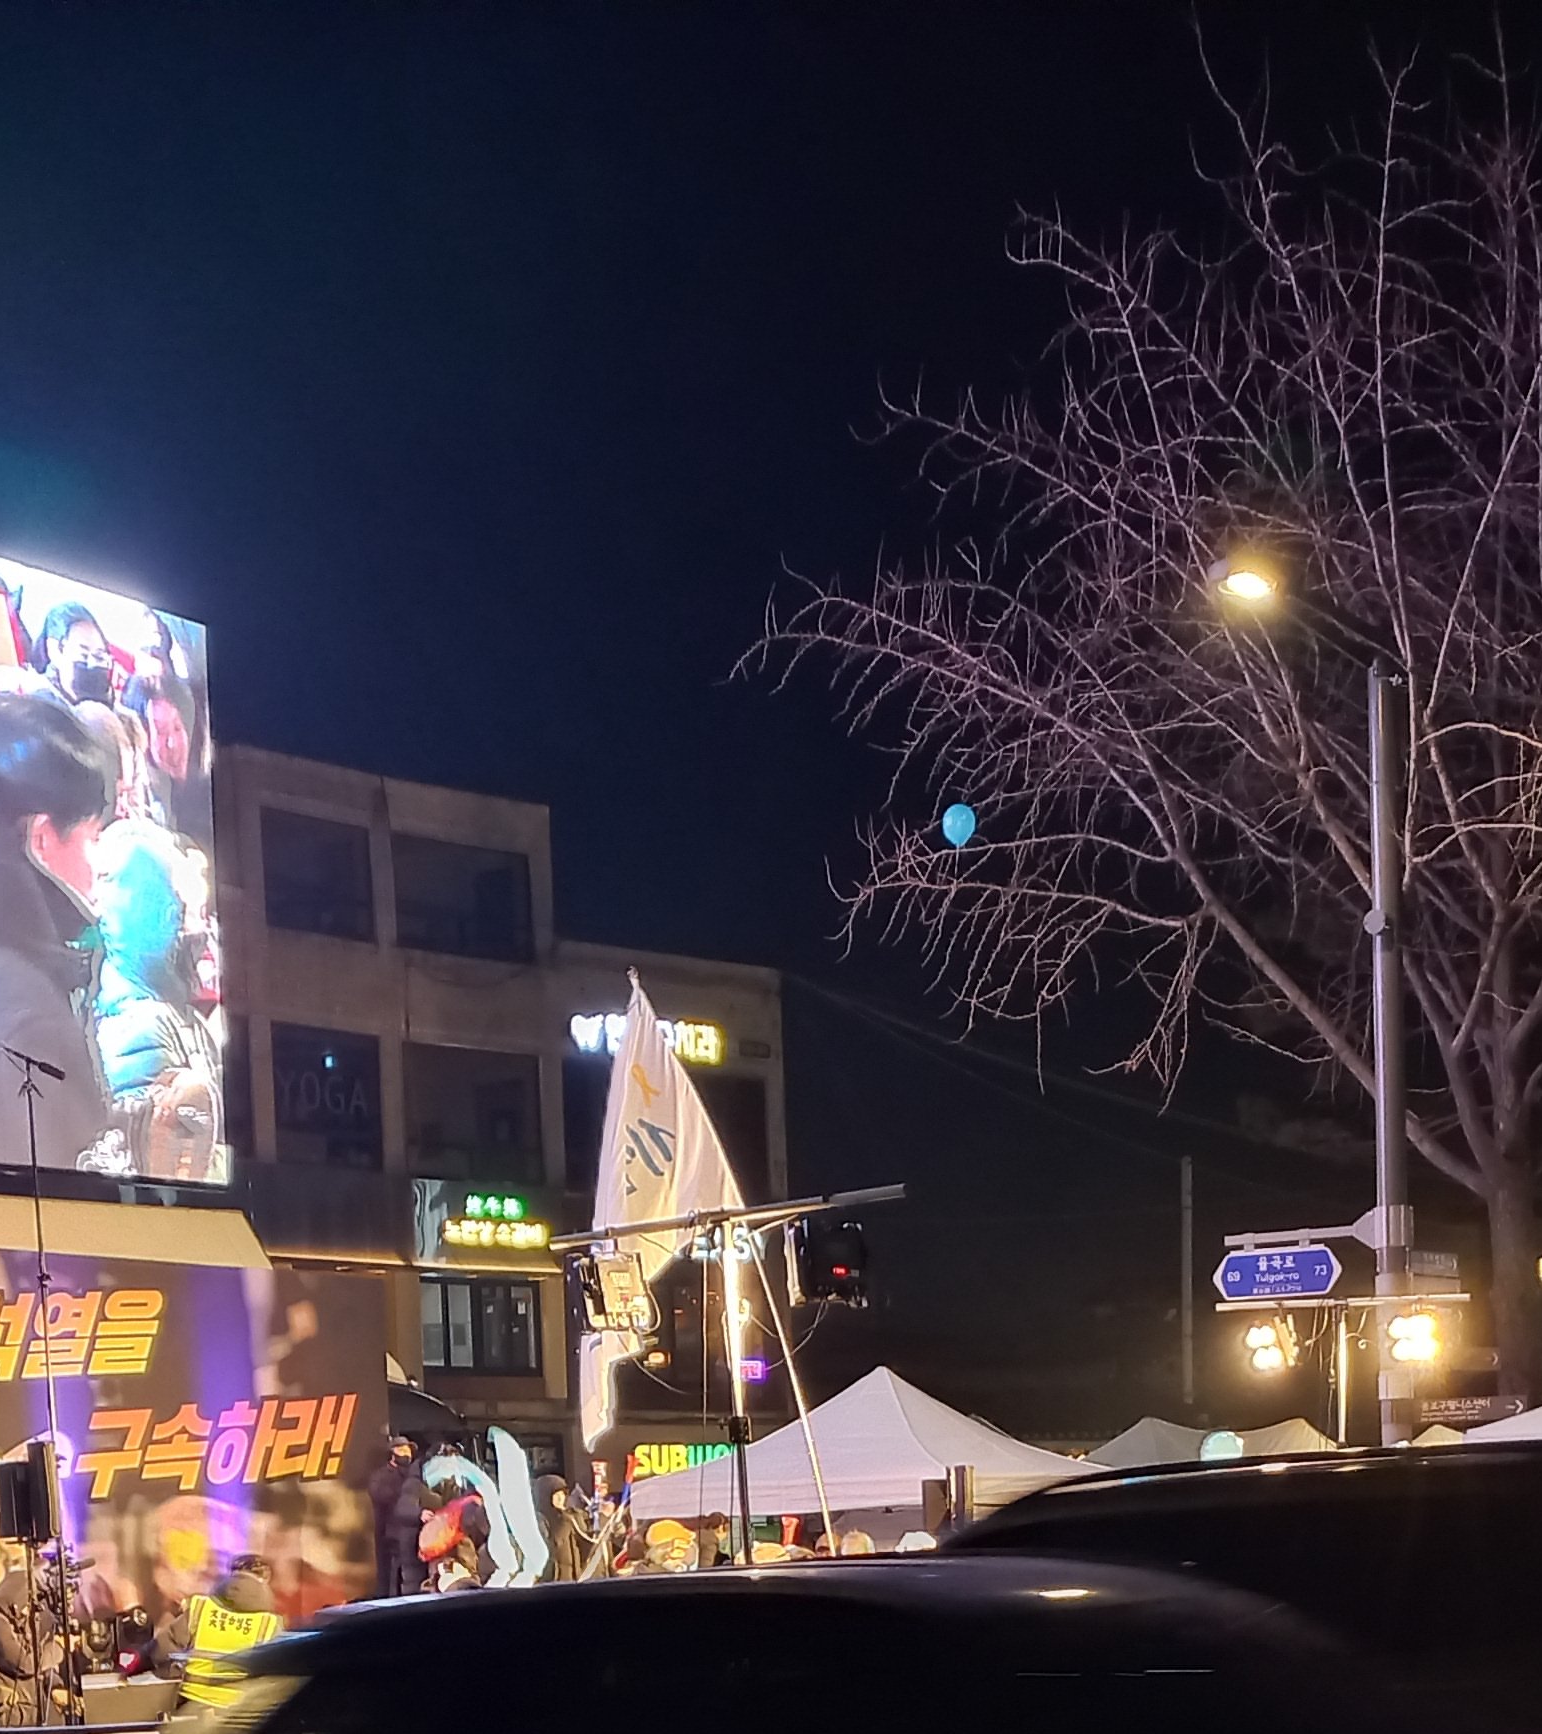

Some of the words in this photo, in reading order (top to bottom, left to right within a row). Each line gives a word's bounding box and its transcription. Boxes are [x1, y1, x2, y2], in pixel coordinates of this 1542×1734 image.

[276, 1070, 369, 1115] YOGA
[1257, 1255, 1296, 1271] 율곡로
[1314, 1264, 1328, 1276] 73
[74, 1393, 357, 1499] 구속하라!
[634, 1444, 736, 1477] SUBW
[208, 1610, 253, 1635] 촛불행동
